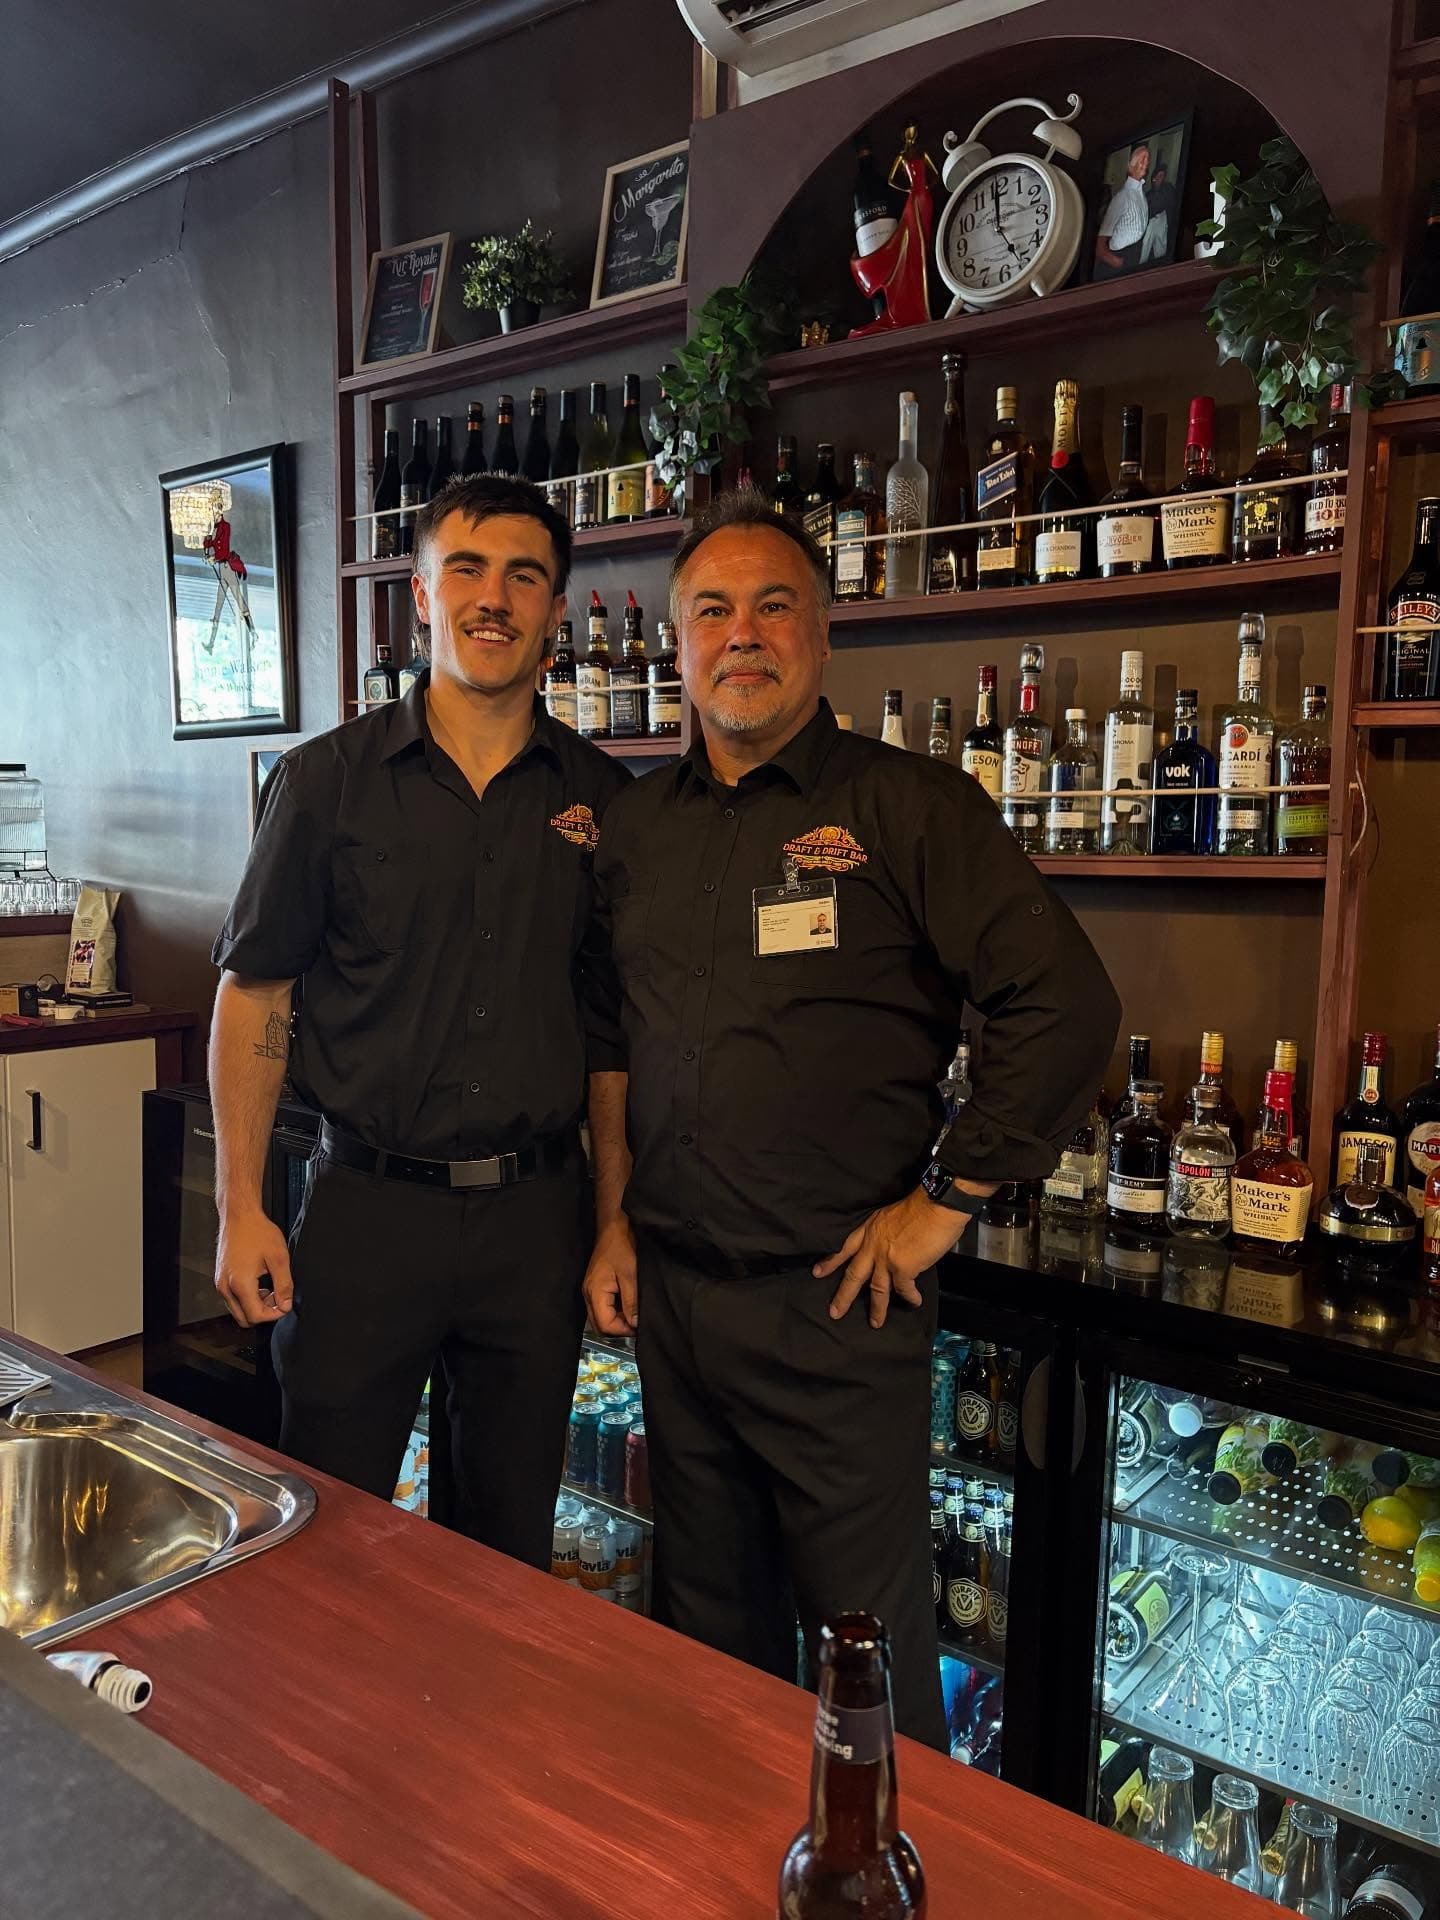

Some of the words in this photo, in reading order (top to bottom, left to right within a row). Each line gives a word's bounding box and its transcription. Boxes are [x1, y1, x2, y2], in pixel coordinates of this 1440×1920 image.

[613, 156, 685, 224] Margarita
[991, 176, 1009, 201] 12
[1015, 175, 1024, 196] 1
[1028, 184, 1042, 206] 2
[973, 191, 986, 212] 11
[959, 212, 976, 236] 10
[1035, 203, 1048, 226] 3
[956, 238, 968, 258] 9
[1028, 228, 1043, 249] 4
[963, 258, 975, 278] 8
[979, 266, 991, 287] 7
[998, 263, 1011, 284] 6
[1178, 516, 1216, 529] Mark
[550, 818, 576, 830] DRAFT
[783, 843, 813, 854] DRAFT
[814, 847, 821, 855] &
[822, 847, 849, 857] DRIFT
[849, 851, 869, 864] BAR
[1235, 1184, 1291, 1201] Maker's
[1248, 1197, 1291, 1213] Mark
[1243, 1211, 1280, 1222] WHISKY
